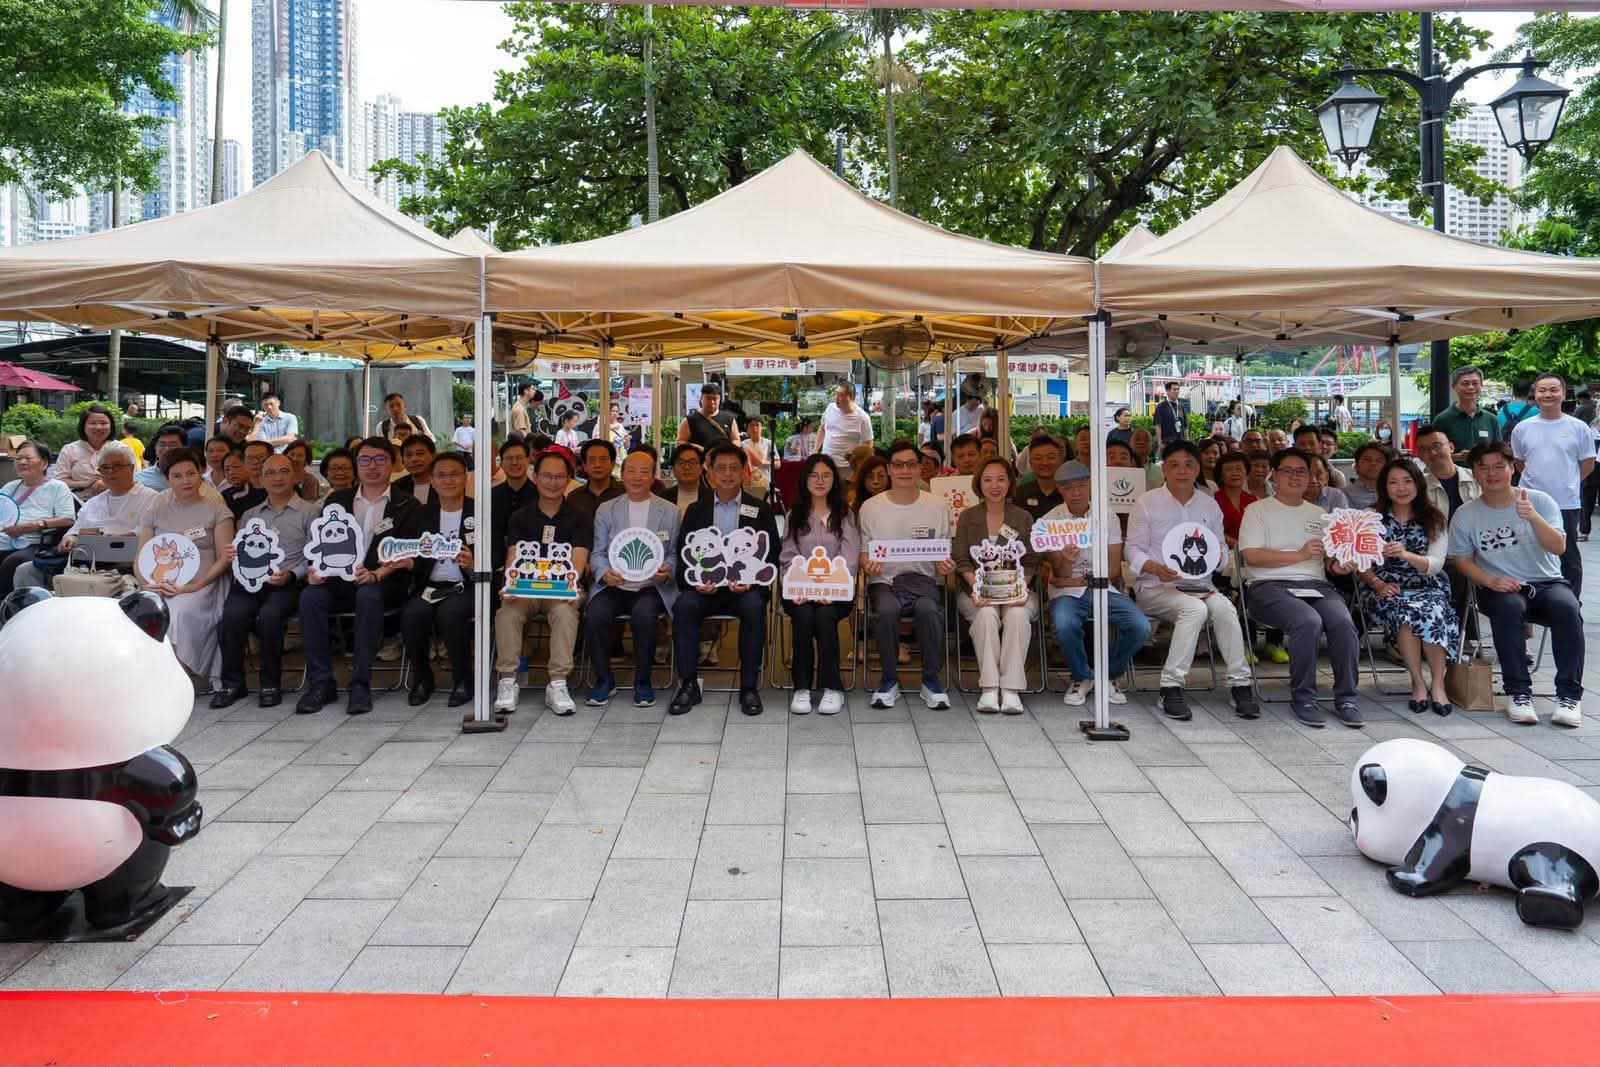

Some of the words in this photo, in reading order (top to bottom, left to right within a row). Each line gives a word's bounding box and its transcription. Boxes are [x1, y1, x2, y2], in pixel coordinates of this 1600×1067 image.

[743, 358, 799, 369] 香港仔坊會
[1008, 361, 1059, 374] 港傷健協會
[1047, 520, 1088, 534] HAPPY
[1034, 533, 1090, 549] BIRTHD
[1330, 521, 1378, 555] 南區
